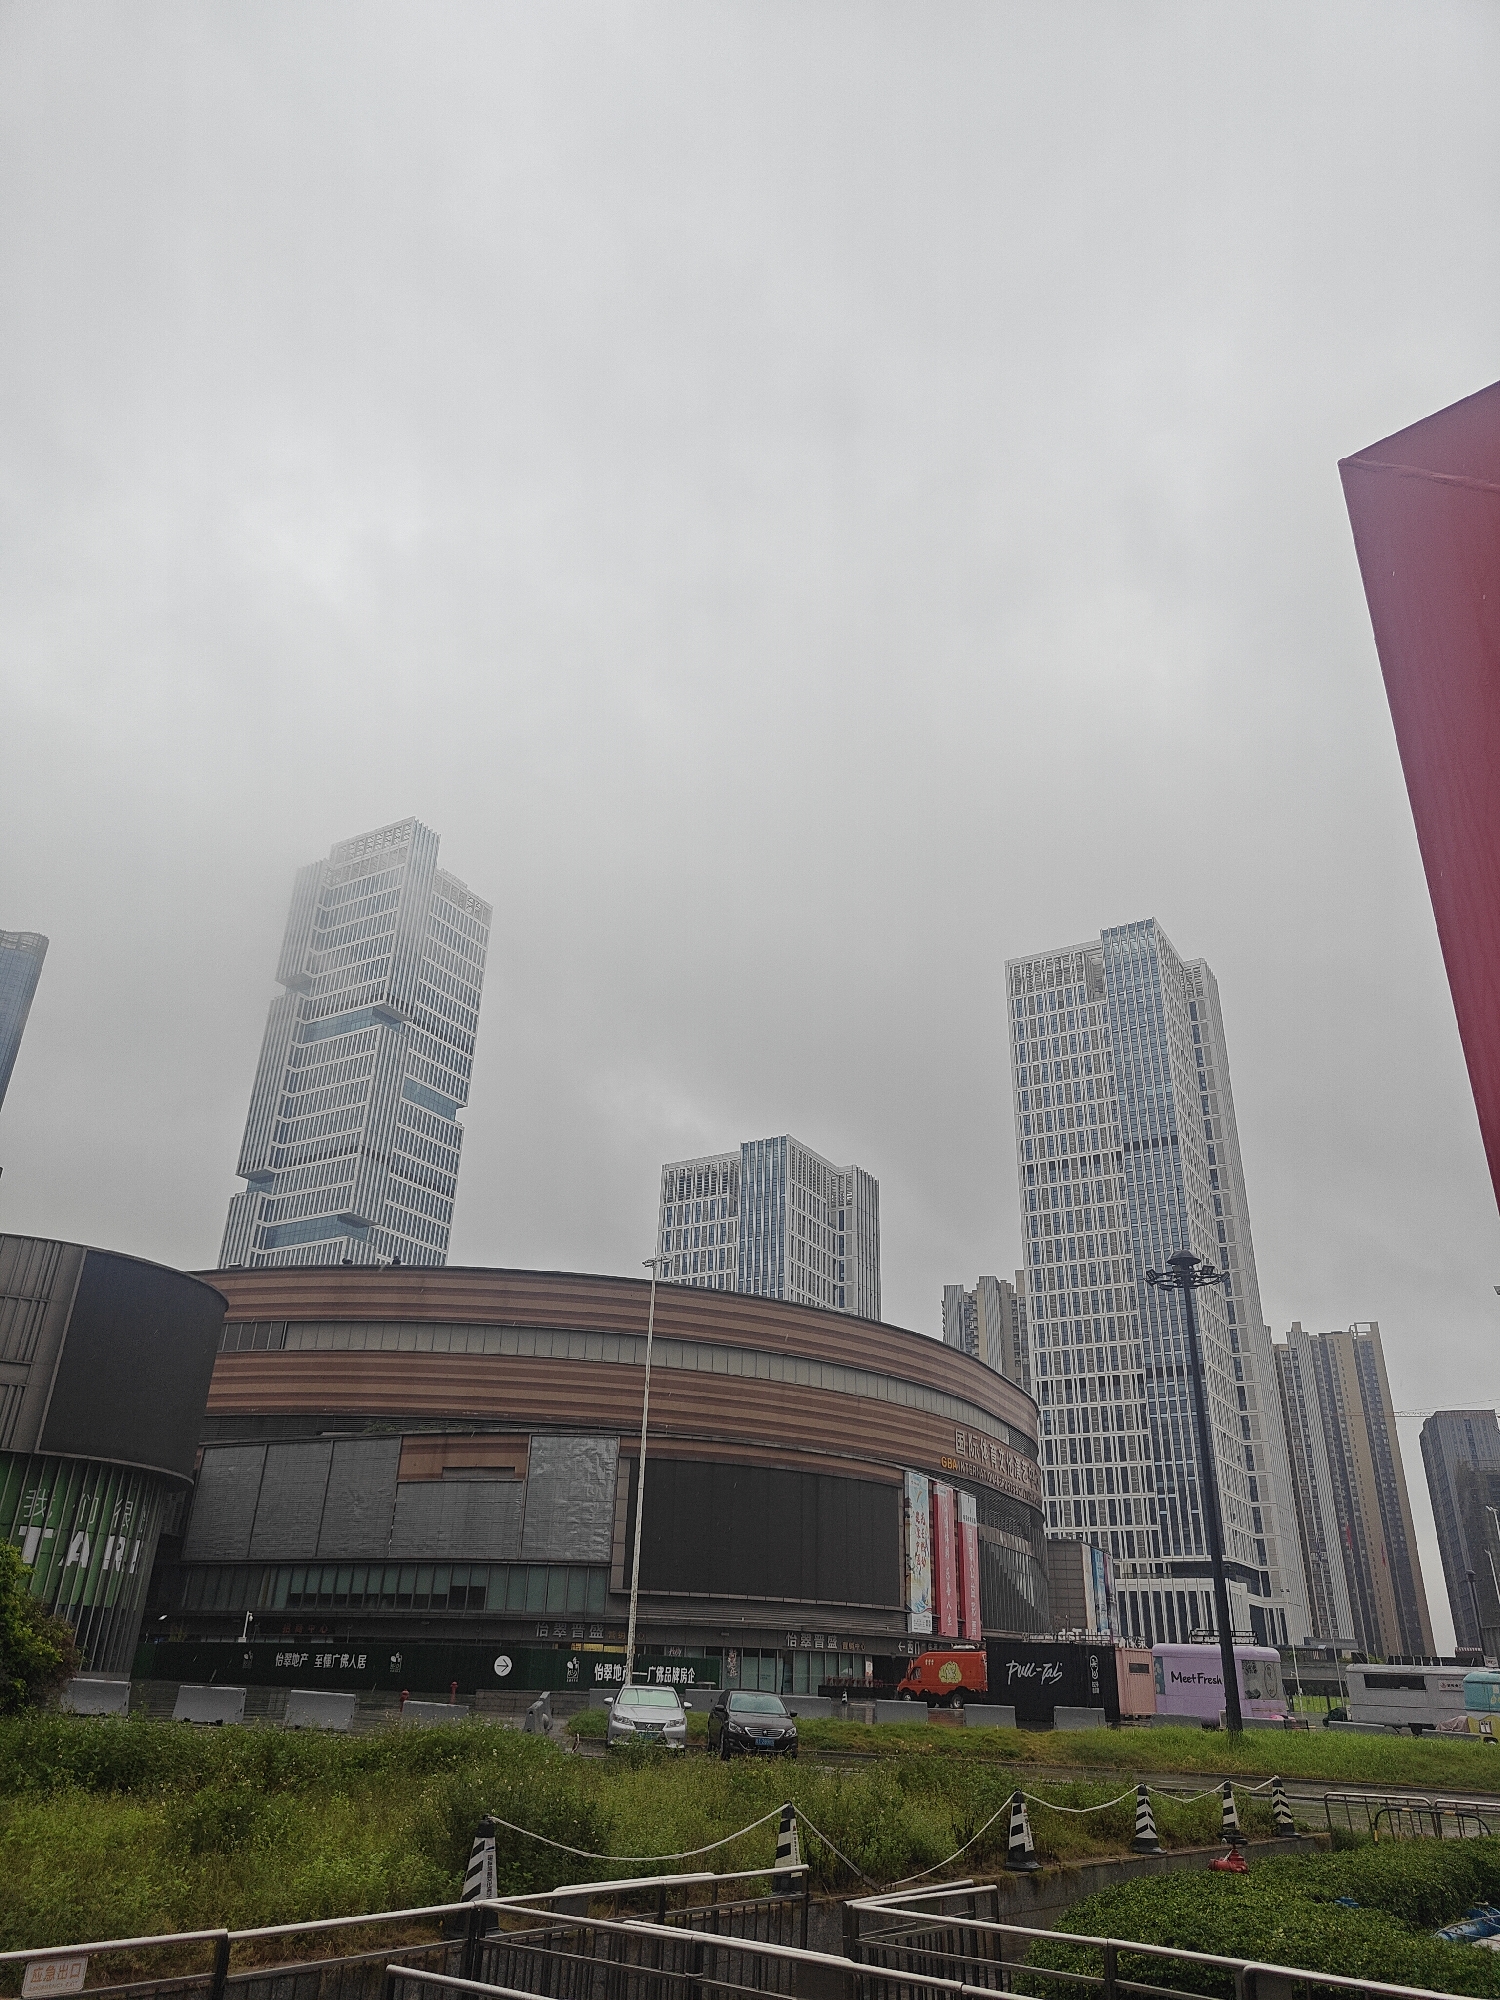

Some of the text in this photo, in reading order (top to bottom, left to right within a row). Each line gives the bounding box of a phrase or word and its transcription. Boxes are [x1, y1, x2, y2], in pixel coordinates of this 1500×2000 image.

[941, 1456, 958, 1470] GBA
[535, 1621, 604, 1639] 怡翠晋盛
[786, 1632, 838, 1650] 怡翠晋盛
[275, 1652, 367, 1669] 怡翠地产 至懂广佛人居
[1170, 1671, 1223, 1685] Meet Fresh
[30, 1963, 81, 1983] 应急出口
